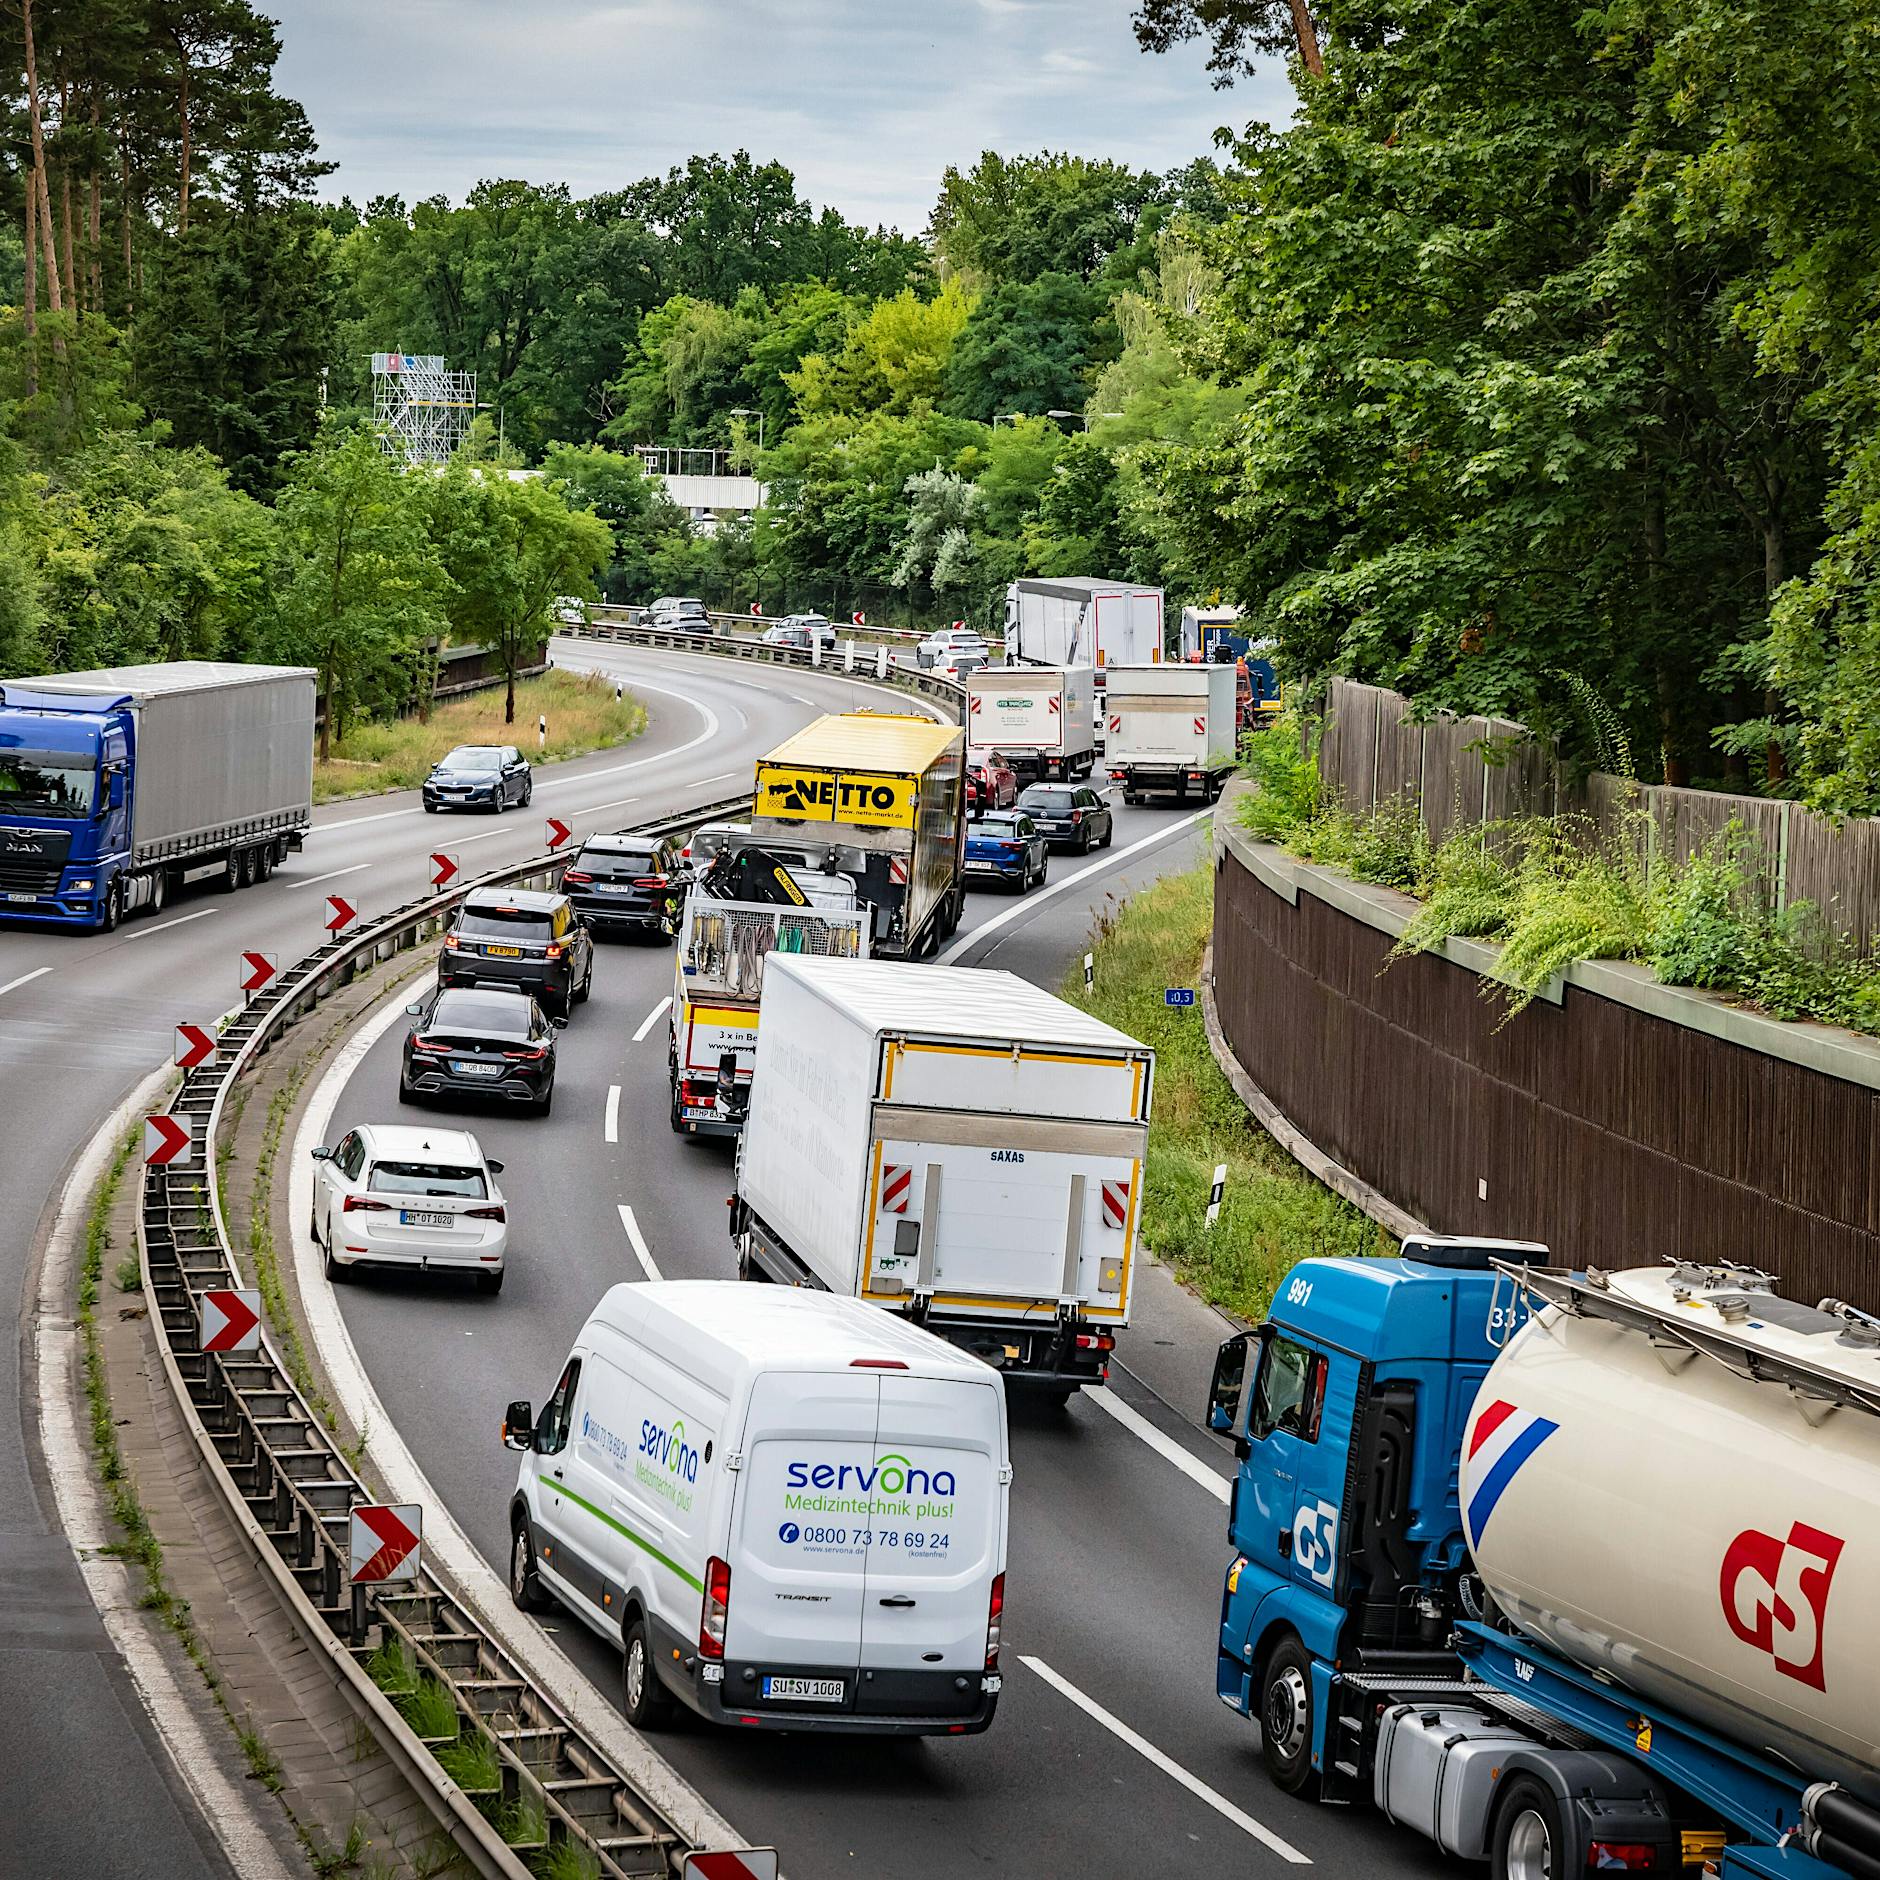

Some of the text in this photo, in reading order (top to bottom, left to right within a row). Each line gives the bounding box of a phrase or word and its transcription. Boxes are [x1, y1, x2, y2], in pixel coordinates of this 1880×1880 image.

[795, 779, 895, 810] NETTO
[838, 808, 904, 819] www.netto-markt.de
[5, 843, 43, 853] MAN
[776, 869, 802, 904] PALFINGER
[719, 1031, 725, 1039] 3
[735, 1033, 743, 1041] in
[405, 1214, 452, 1225] HH OT 1020
[1287, 1277, 1314, 1307] 991
[639, 1419, 698, 1484] servona
[786, 1455, 956, 1496] servona
[785, 1494, 954, 1520] Medizintechnik plus!
[804, 1527, 950, 1549] 0800 73 78 69 24
[1293, 1500, 1339, 1589] GS
[803, 1545, 947, 1559] www.servona.de (kostenfrei)
[774, 1593, 832, 1603] TRANSIT
[1720, 1520, 1845, 1694] GS
[772, 1679, 841, 1696] SU SV 1008
